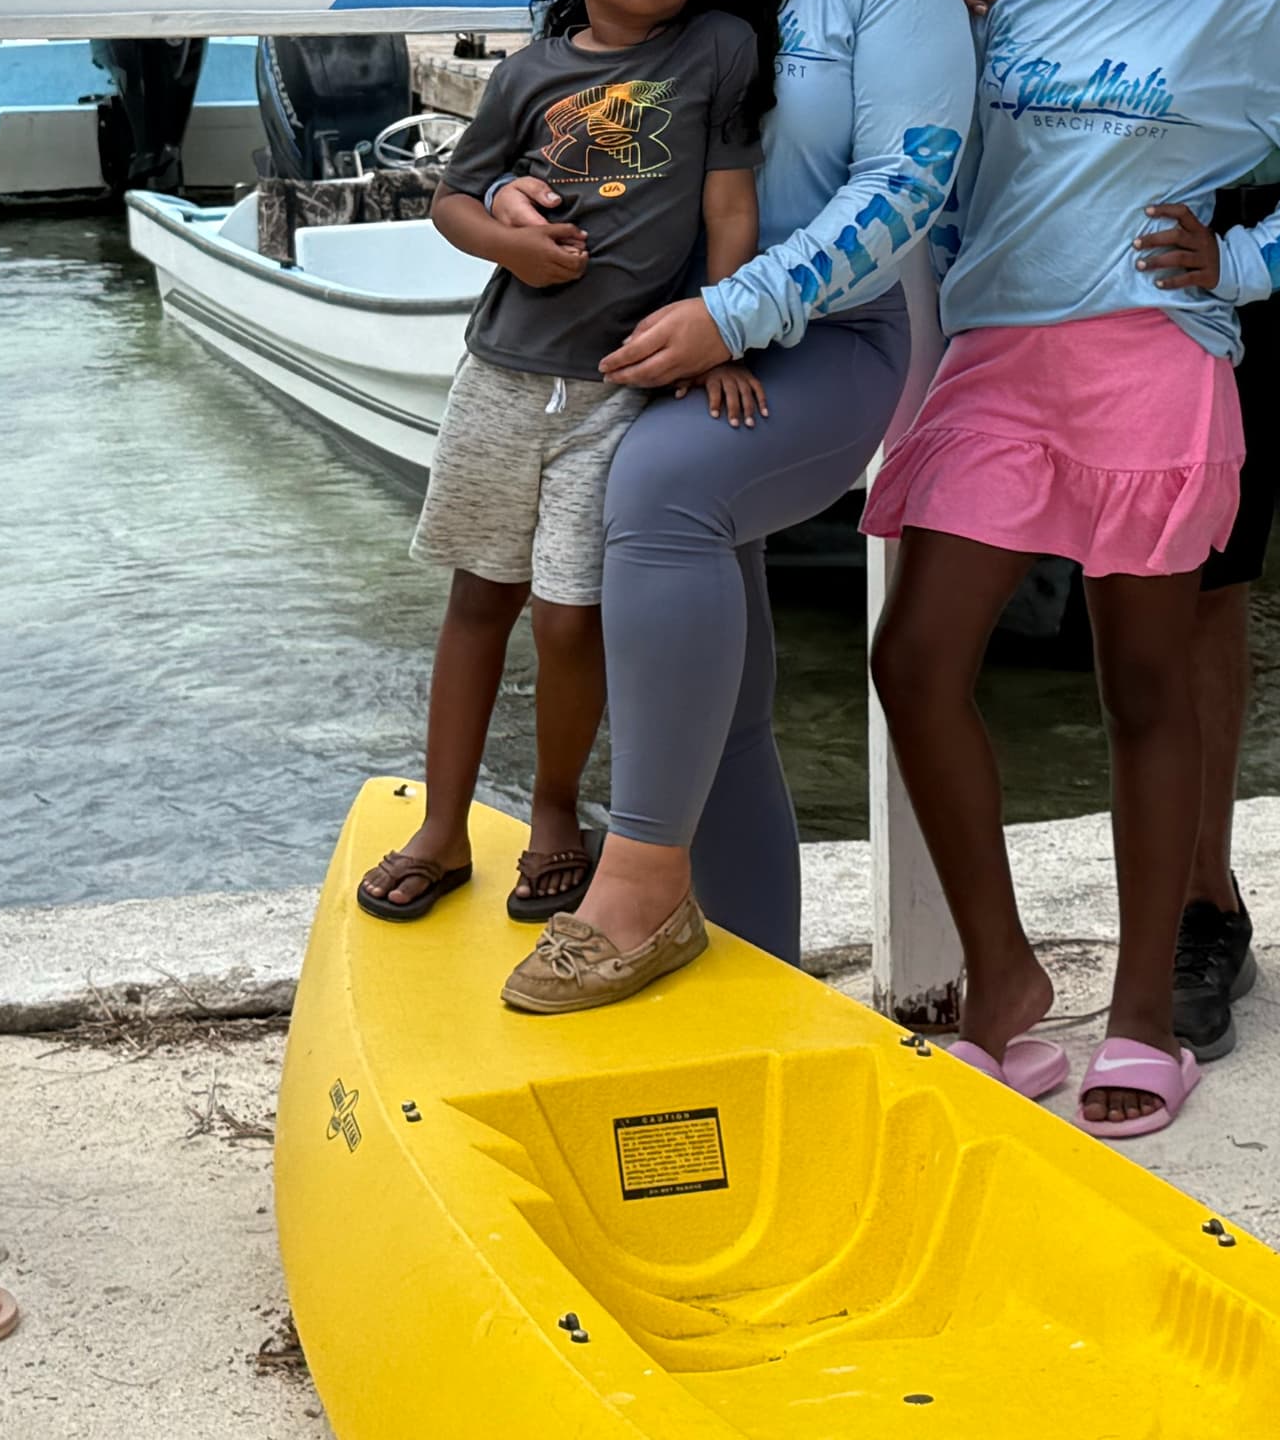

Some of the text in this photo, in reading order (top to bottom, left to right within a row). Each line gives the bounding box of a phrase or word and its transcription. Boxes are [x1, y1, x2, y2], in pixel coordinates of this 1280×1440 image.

[1012, 57, 1188, 120] Blue Marlin
[1033, 115, 1169, 140] BEACH RESORT
[642, 1112, 691, 1124] CAUTION
